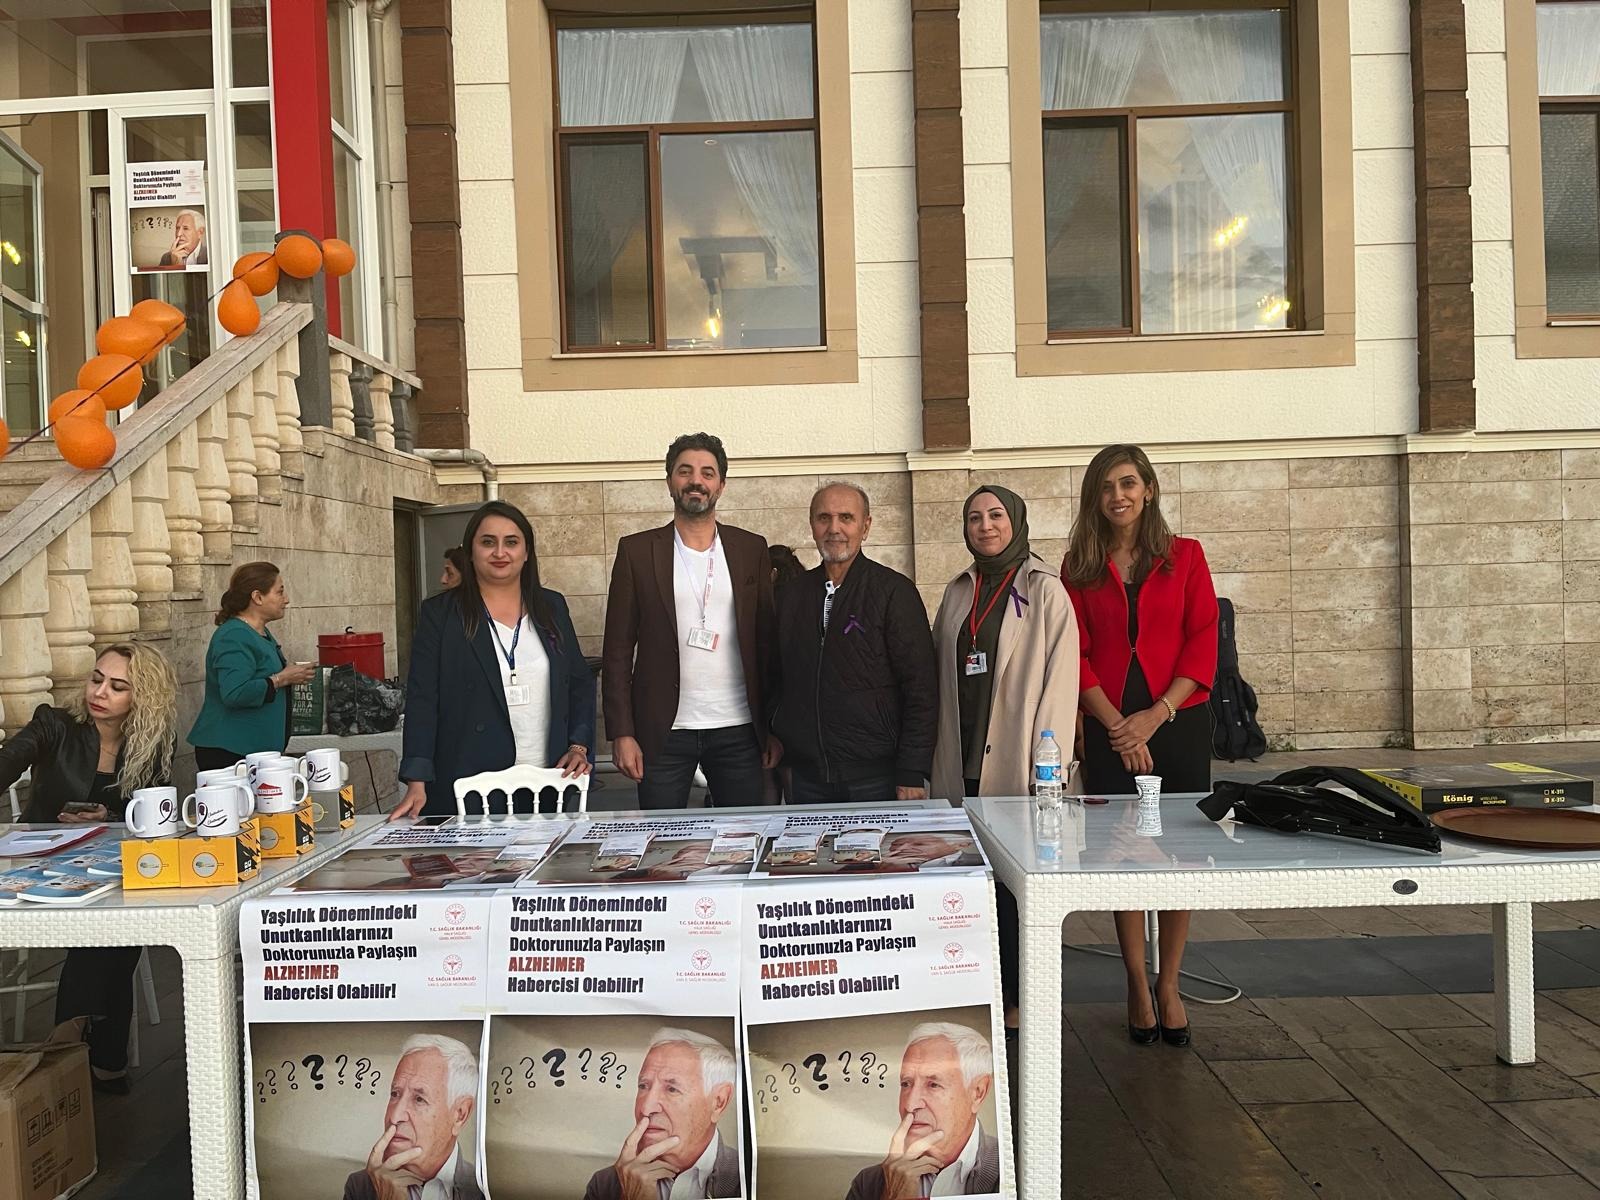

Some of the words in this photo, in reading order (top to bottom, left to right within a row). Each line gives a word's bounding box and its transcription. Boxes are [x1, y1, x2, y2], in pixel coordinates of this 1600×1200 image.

[512, 897, 565, 914] Yaşlılık
[569, 896, 667, 912] Dönemindeki
[757, 901, 812, 921] Yaşlılık
[816, 894, 914, 916] Dönemindeki
[261, 908, 315, 926] Yaşlılık
[319, 904, 417, 923] Dönemindeki
[510, 917, 642, 932] Unutkanlıklarınızı
[758, 918, 892, 940] Unutkanlıklarınızı
[261, 927, 393, 944] Unutkanlıklarınızı
[263, 946, 354, 961] Doktorunuzla
[358, 945, 417, 961] Paylaşın
[510, 937, 601, 952] Doktorunuzla
[605, 937, 665, 954] Paylaşın
[760, 940, 851, 959] Doktorunuzla
[856, 935, 916, 952] Paylaşın
[264, 964, 339, 981] ALZHEIMER
[508, 957, 585, 972] ALZHEIMER
[761, 959, 838, 980] ALZHEIMER
[264, 984, 333, 1000] Habercisi
[337, 984, 396, 1000] Olabilir!
[508, 977, 578, 993] Habercisi
[583, 977, 644, 993] Olabilir!
[762, 980, 835, 1000] Habercisi
[839, 974, 900, 994] Olabilir!
